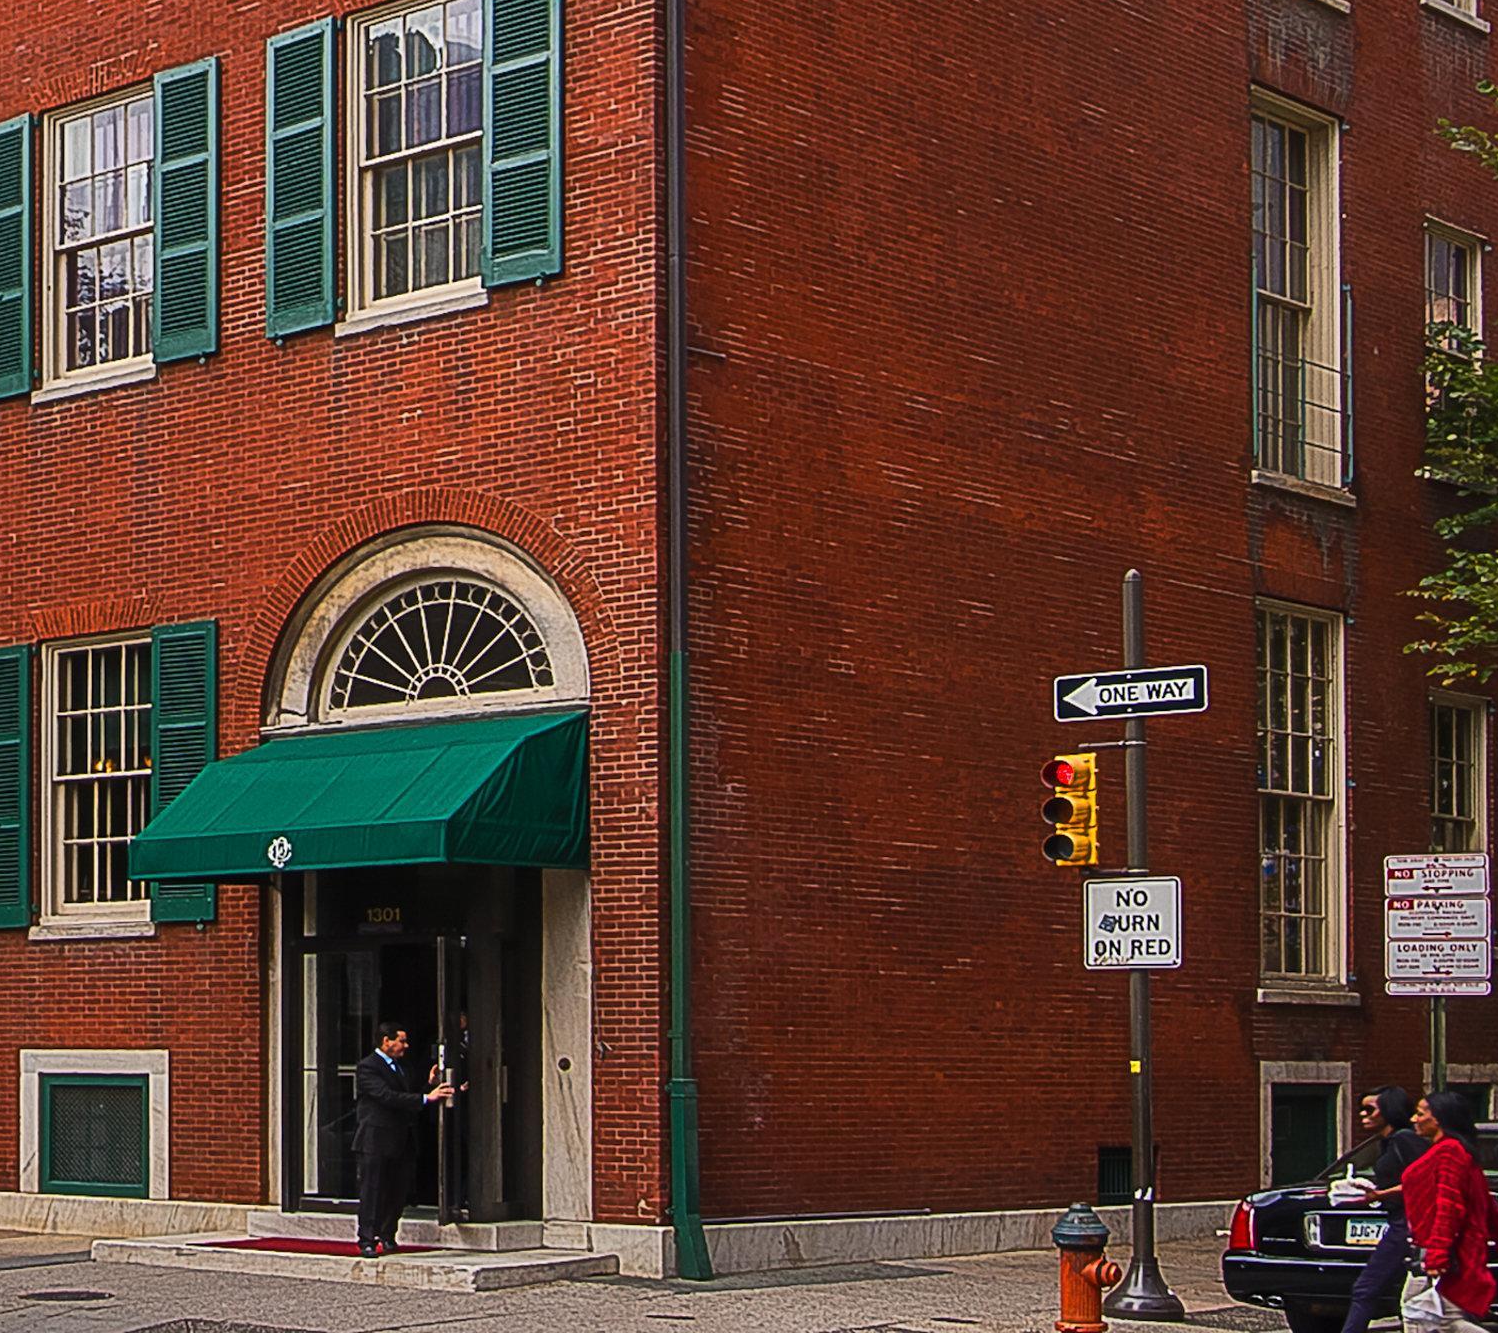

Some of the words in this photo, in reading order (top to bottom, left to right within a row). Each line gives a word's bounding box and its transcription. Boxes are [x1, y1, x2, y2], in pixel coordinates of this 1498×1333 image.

[1099, 685, 1138, 703] ONE
[1146, 681, 1187, 700] WAY
[1393, 870, 1410, 879] NO
[1422, 869, 1474, 879] STOPPING
[1116, 889, 1149, 908] NO
[1393, 901, 1410, 909] NO
[1417, 900, 1464, 909] PARKING
[366, 908, 401, 922] 1301
[1100, 914, 1159, 933] URN
[1095, 939, 1121, 957] ON
[1131, 939, 1171, 957] RED
[1397, 944, 1445, 953] LOADING
[1450, 944, 1478, 953] ONLY
[1350, 1224, 1387, 1238] DJG-7
